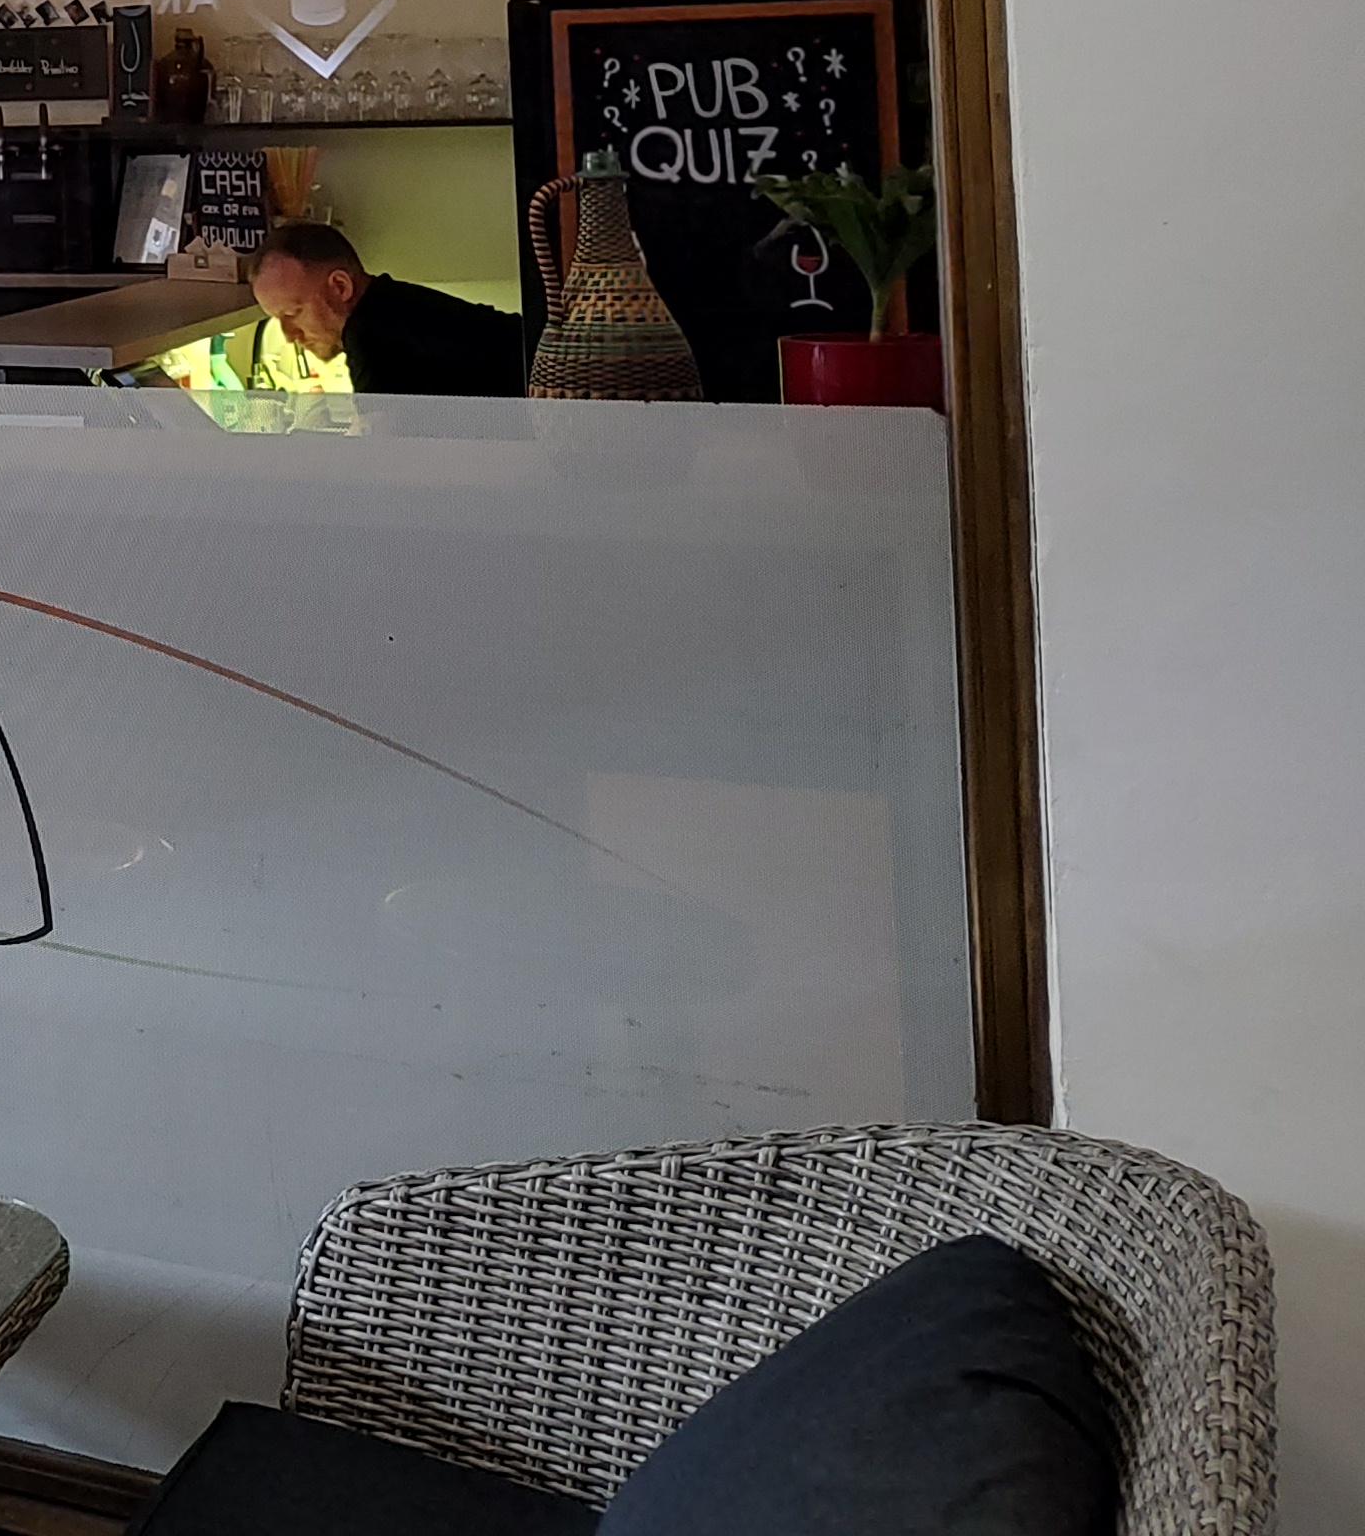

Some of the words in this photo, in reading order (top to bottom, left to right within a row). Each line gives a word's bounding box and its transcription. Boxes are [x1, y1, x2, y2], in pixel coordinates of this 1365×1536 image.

[647, 57, 769, 120] PUB
[631, 125, 787, 185] QUIZ
[200, 170, 261, 197] CASH
[223, 203, 239, 216] OR
[201, 225, 265, 249] REVOLUT
